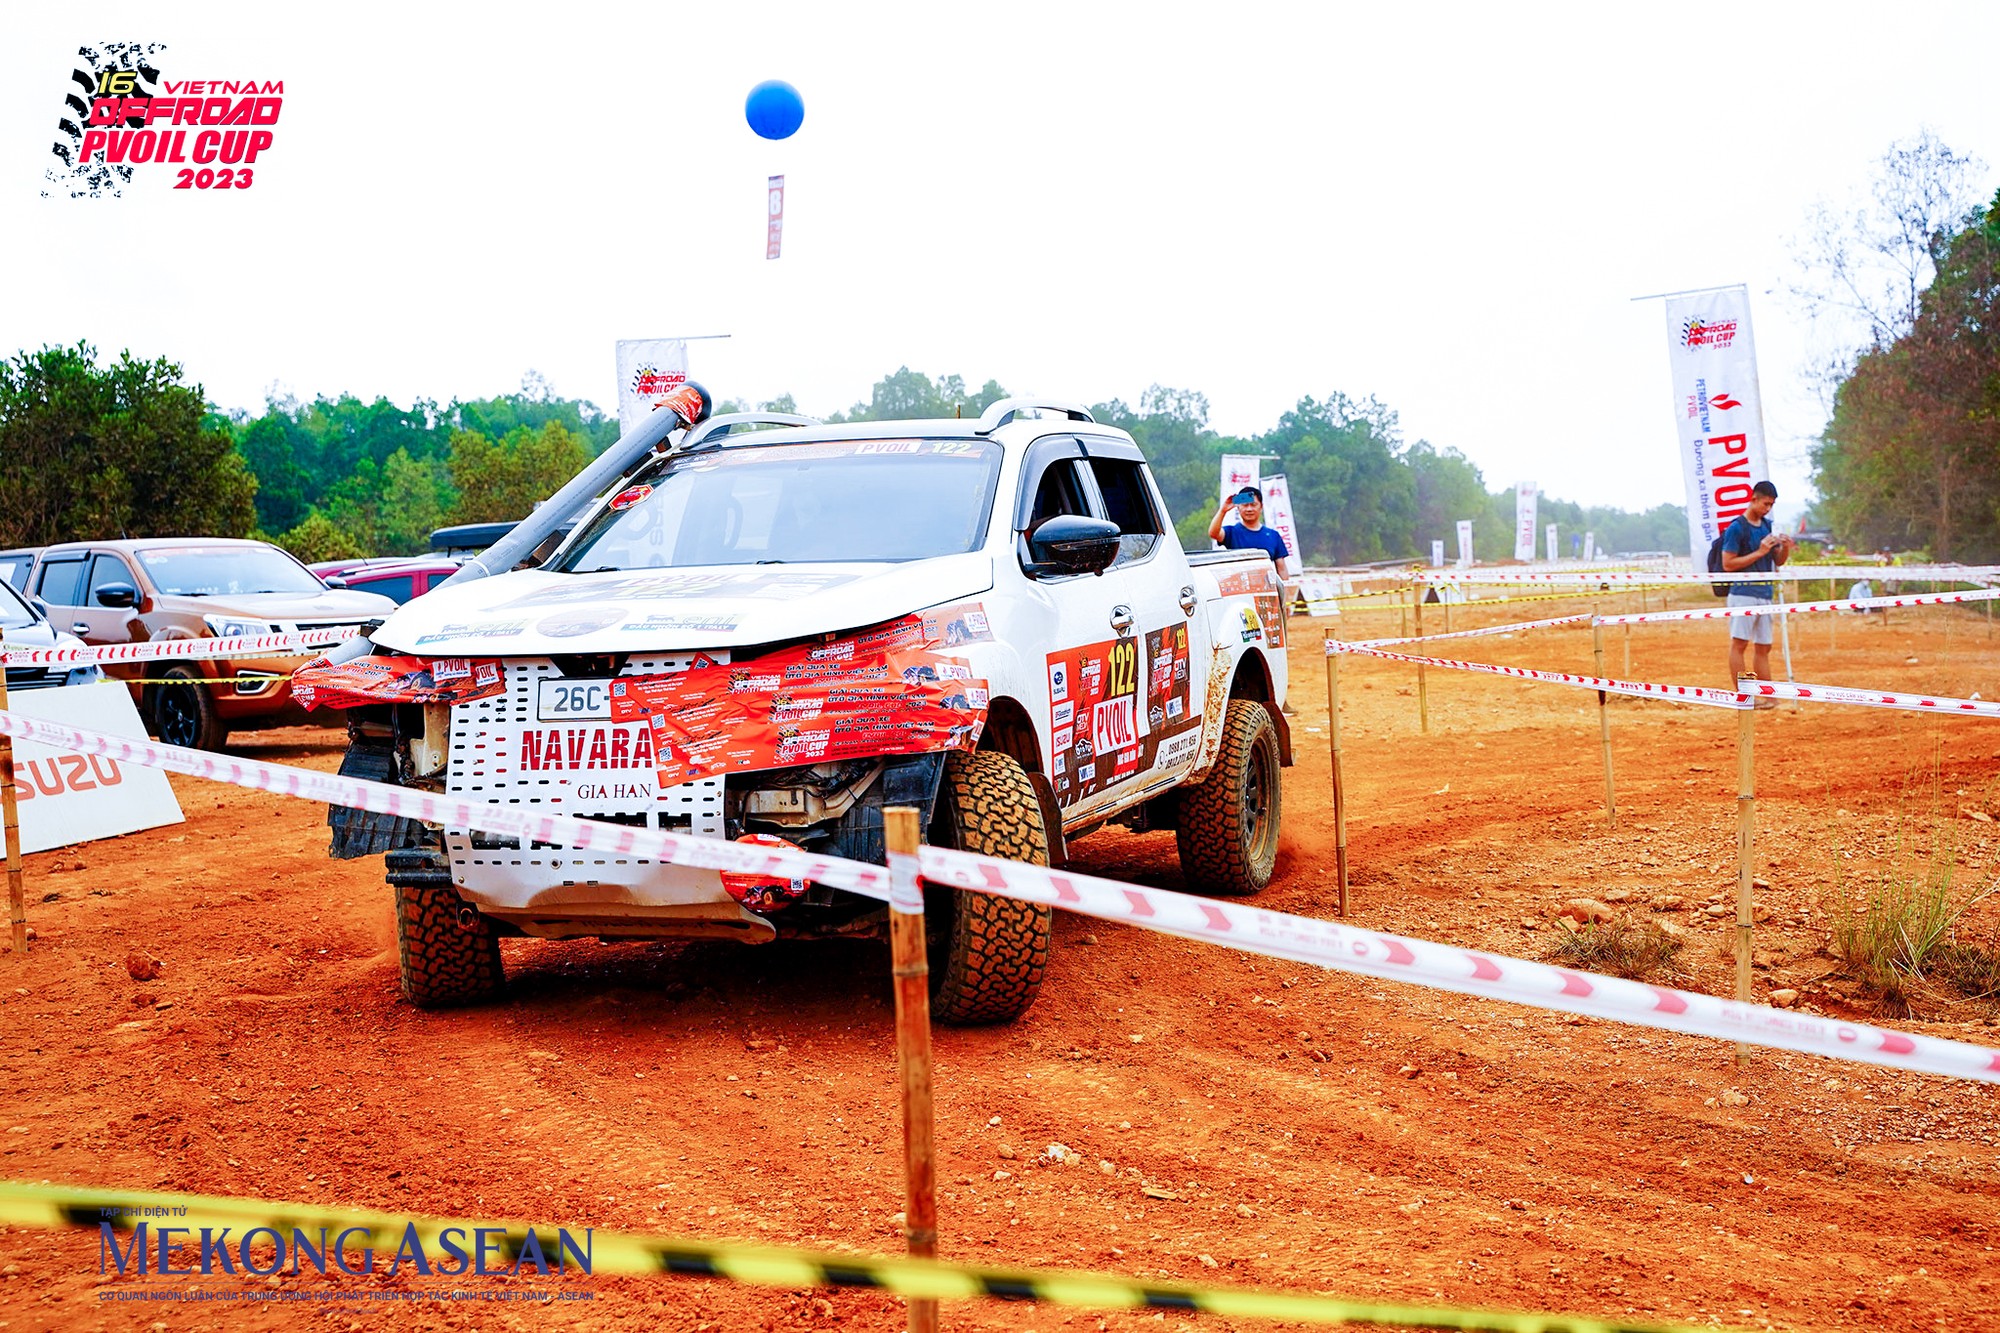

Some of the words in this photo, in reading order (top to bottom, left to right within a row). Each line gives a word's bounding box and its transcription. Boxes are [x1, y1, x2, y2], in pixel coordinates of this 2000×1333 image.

[1687, 395, 1698, 419] PVOIL
[861, 443, 912, 454] PVOIL
[931, 442, 972, 454] 122
[1700, 494, 1710, 520] thêm
[1176, 628, 1186, 649] 122
[811, 644, 854, 658] OFFROAD
[444, 660, 468, 672] PVOIL
[1108, 642, 1135, 697] 122
[734, 680, 780, 688] OFFROAD
[776, 702, 824, 712] OFFROAD
[775, 710, 802, 720] PVOIL
[802, 710, 822, 719] CUP
[1098, 700, 1132, 750] PVOIL
[783, 734, 830, 744] OFFROAD
[520, 728, 652, 771] NAVARA
[782, 743, 809, 754] PVOIL
[808, 741, 828, 750] CUP
[0, 754, 122, 803] SUZU
[578, 784, 608, 800] GIA
[614, 783, 652, 799] HAN
